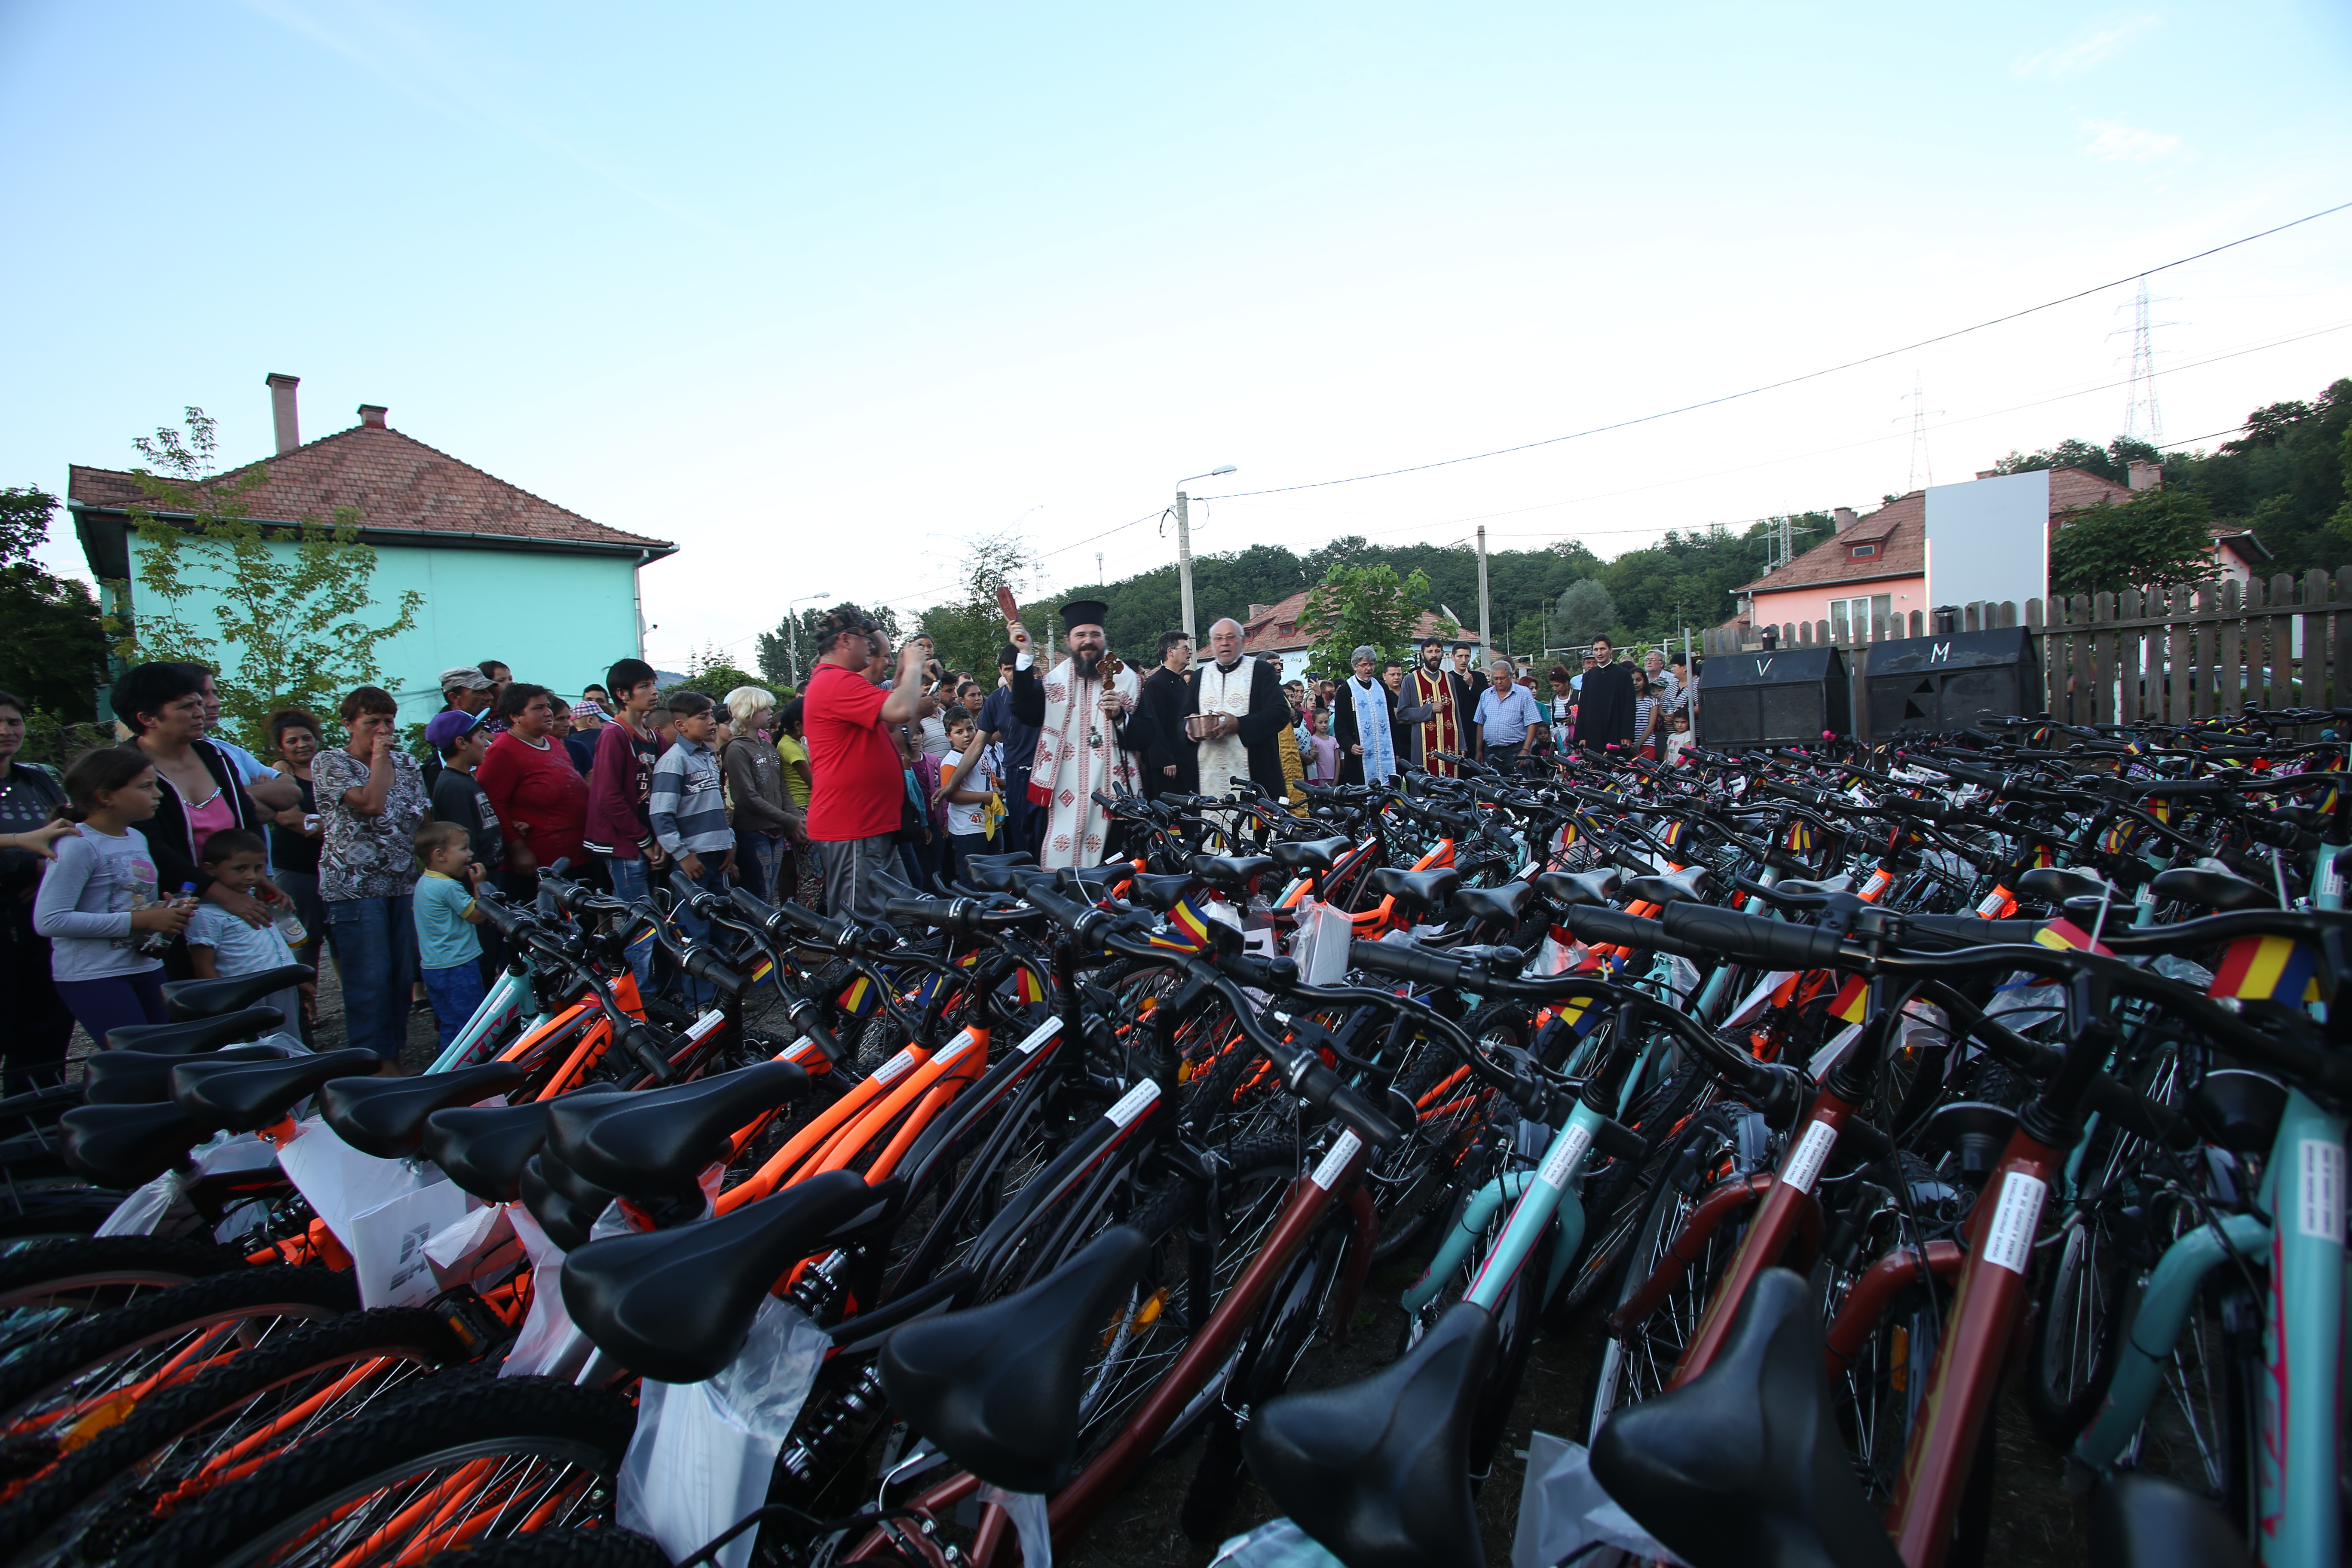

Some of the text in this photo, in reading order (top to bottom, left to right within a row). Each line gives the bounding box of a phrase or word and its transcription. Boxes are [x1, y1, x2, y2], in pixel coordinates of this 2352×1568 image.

[1930, 642, 1950, 663] M
[1756, 658, 1773, 677] V
[1560, 1149, 1571, 1163] EUROPEI
[1797, 1145, 1809, 1164] EPISCOPIA
[1808, 1147, 1819, 1164] EUROPEI
[1999, 1207, 2010, 1234] EPISCOPIA
[2013, 1209, 2024, 1231] EUROPEI
[389, 1257, 429, 1292] DH
